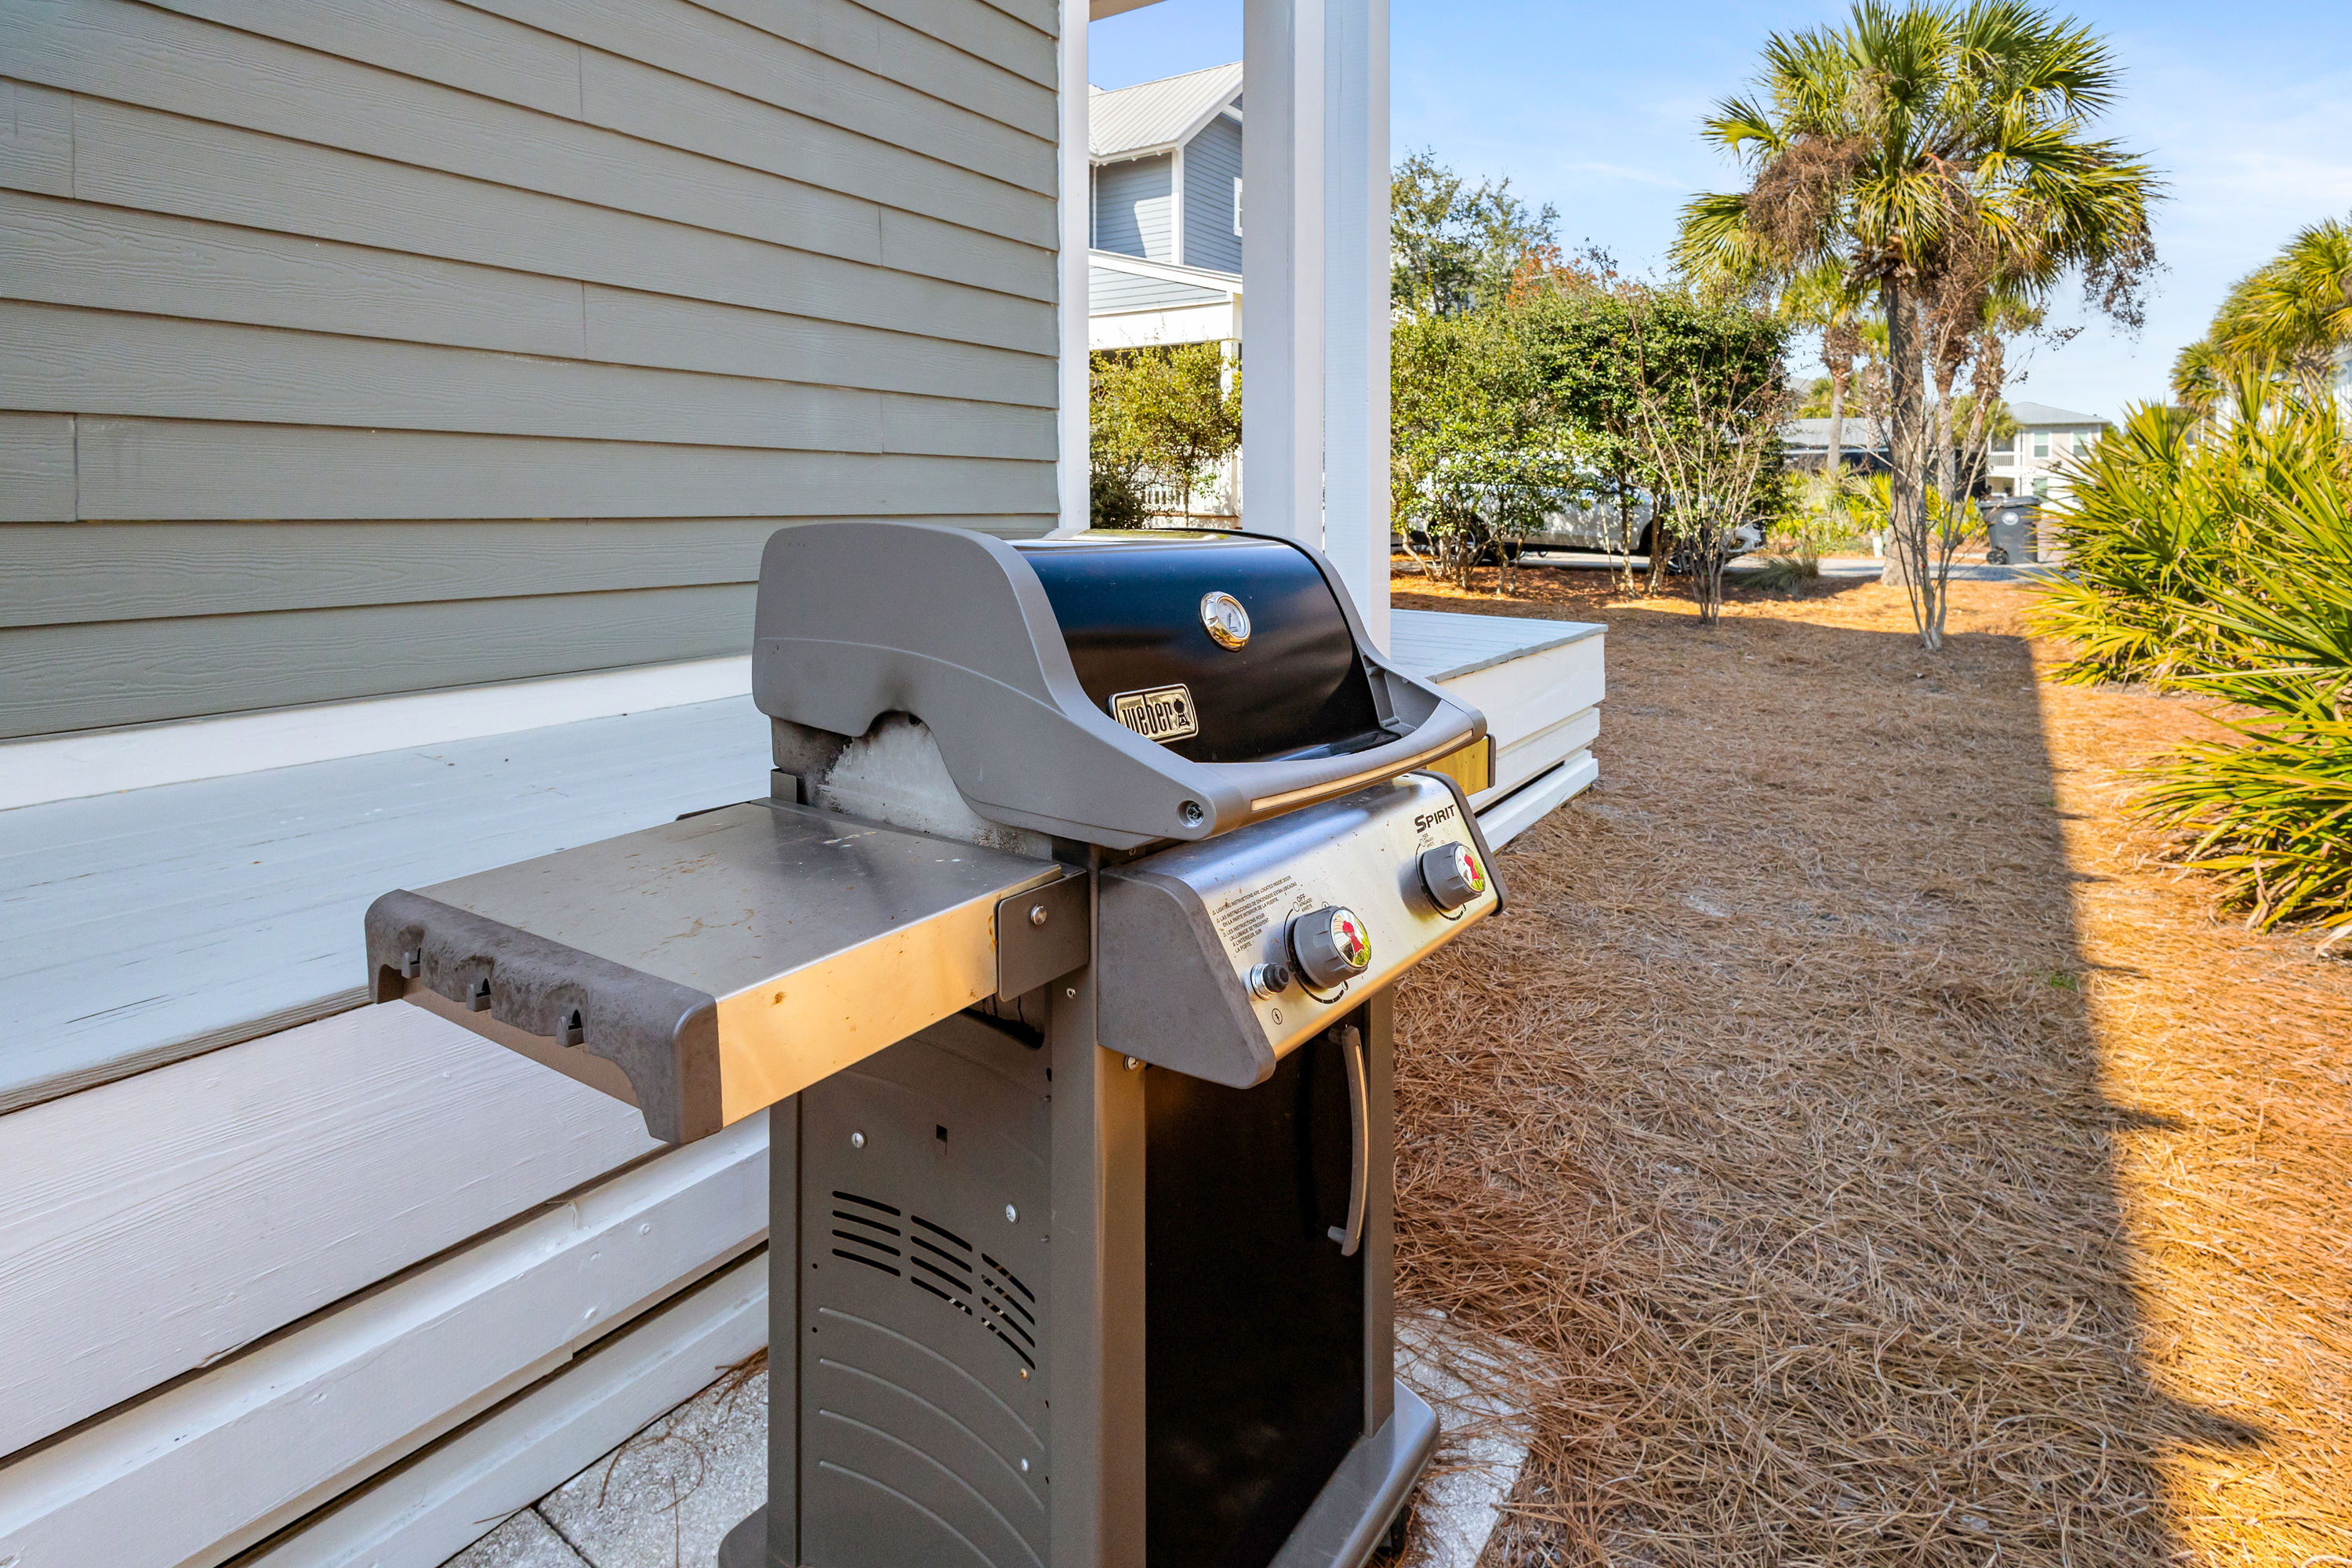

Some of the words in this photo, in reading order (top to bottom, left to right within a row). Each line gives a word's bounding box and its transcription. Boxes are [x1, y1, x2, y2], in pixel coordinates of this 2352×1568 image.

[1121, 694, 1173, 735] weber
[1414, 804, 1454, 833] SPIRIT
[1231, 892, 1254, 906] INSTRUCTIONS
[1260, 884, 1273, 893] LOCATED
[1297, 893, 1306, 902] OFF
[1227, 902, 1252, 918] INSTRUCCIONES
[1232, 914, 1243, 923] PARTE
[1243, 906, 1258, 917] INTERIOR
[1233, 917, 1256, 931] INSTRUCTIONS
[1253, 917, 1269, 928] TROUVENT
